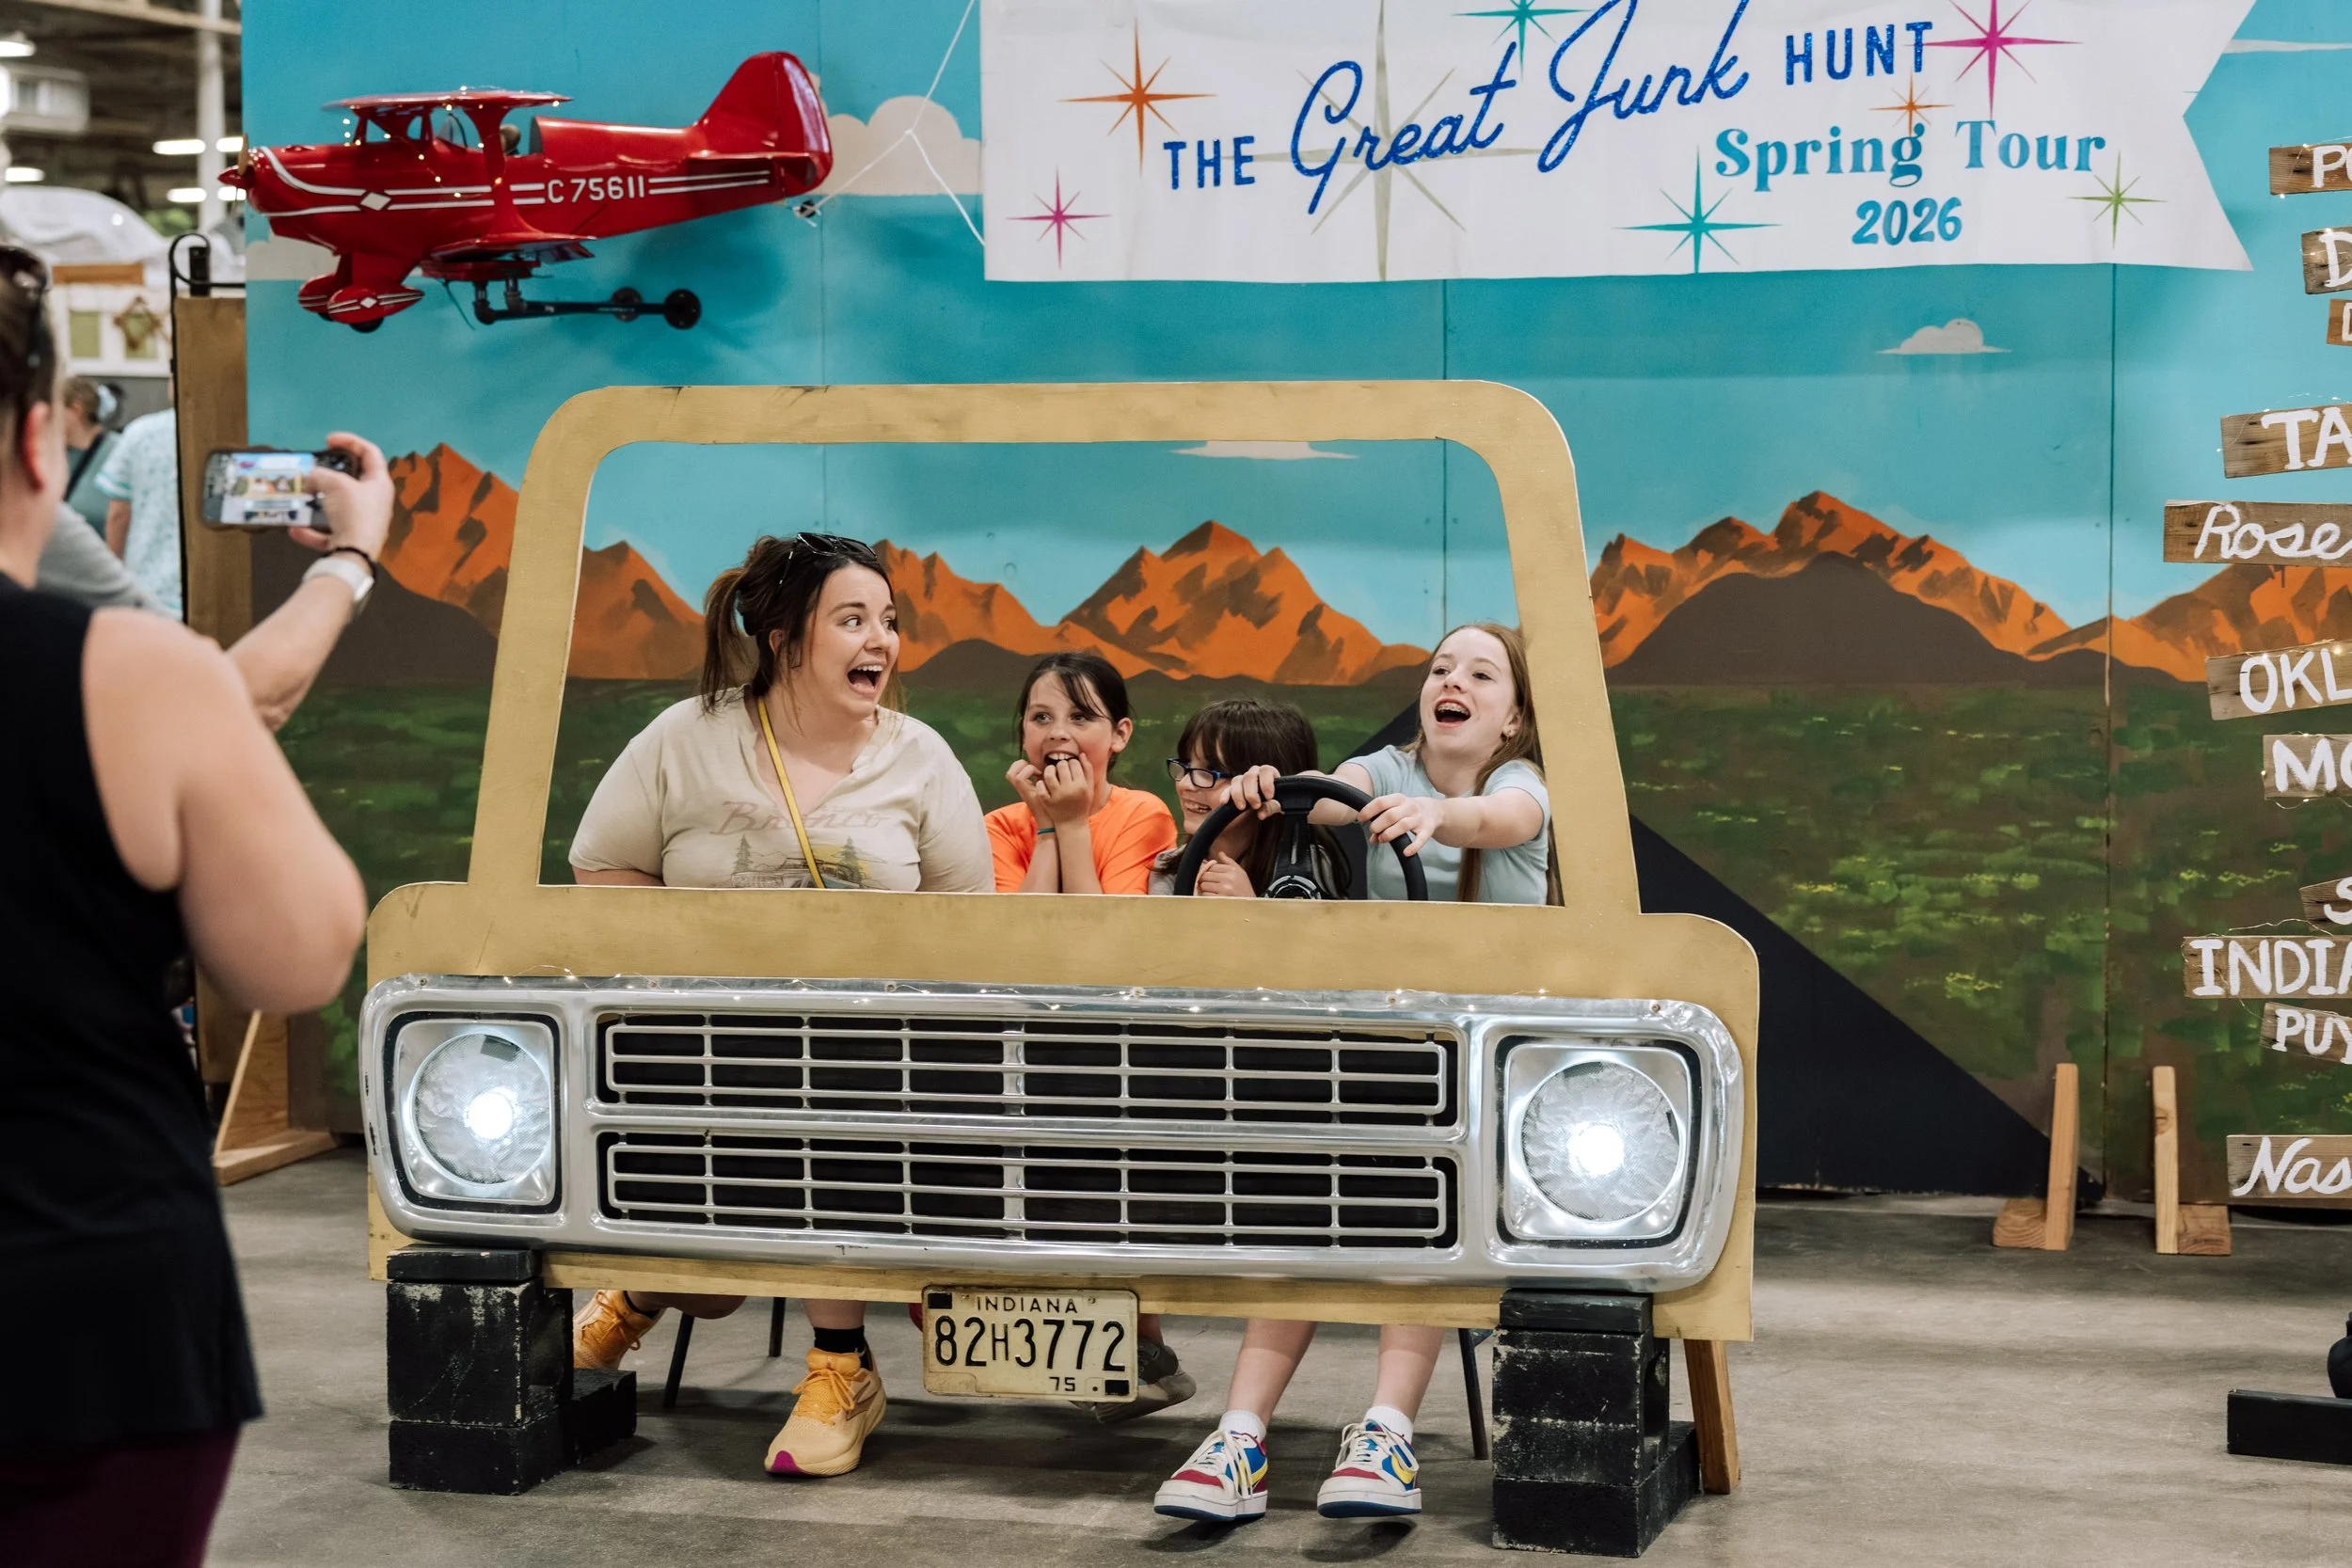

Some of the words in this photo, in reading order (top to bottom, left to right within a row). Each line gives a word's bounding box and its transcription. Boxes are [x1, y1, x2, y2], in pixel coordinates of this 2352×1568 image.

[1163, 135, 1255, 190] THE
[1291, 41, 1516, 214] Great
[1537, 0, 1750, 172] Junk
[1785, 21, 1933, 86] HUNT
[1715, 122, 1926, 192] Spring
[1954, 119, 2106, 171] Tour
[1851, 197, 1963, 245] 2026
[2261, 406, 2352, 469] TA
[2194, 503, 2352, 560] Rose
[2239, 648, 2352, 713] OKL
[2232, 1136, 2352, 1196] Nas
[977, 1296, 1078, 1314] INDIANA
[935, 1315, 1126, 1372] 82H3772
[1049, 1376, 1076, 1392] 75
